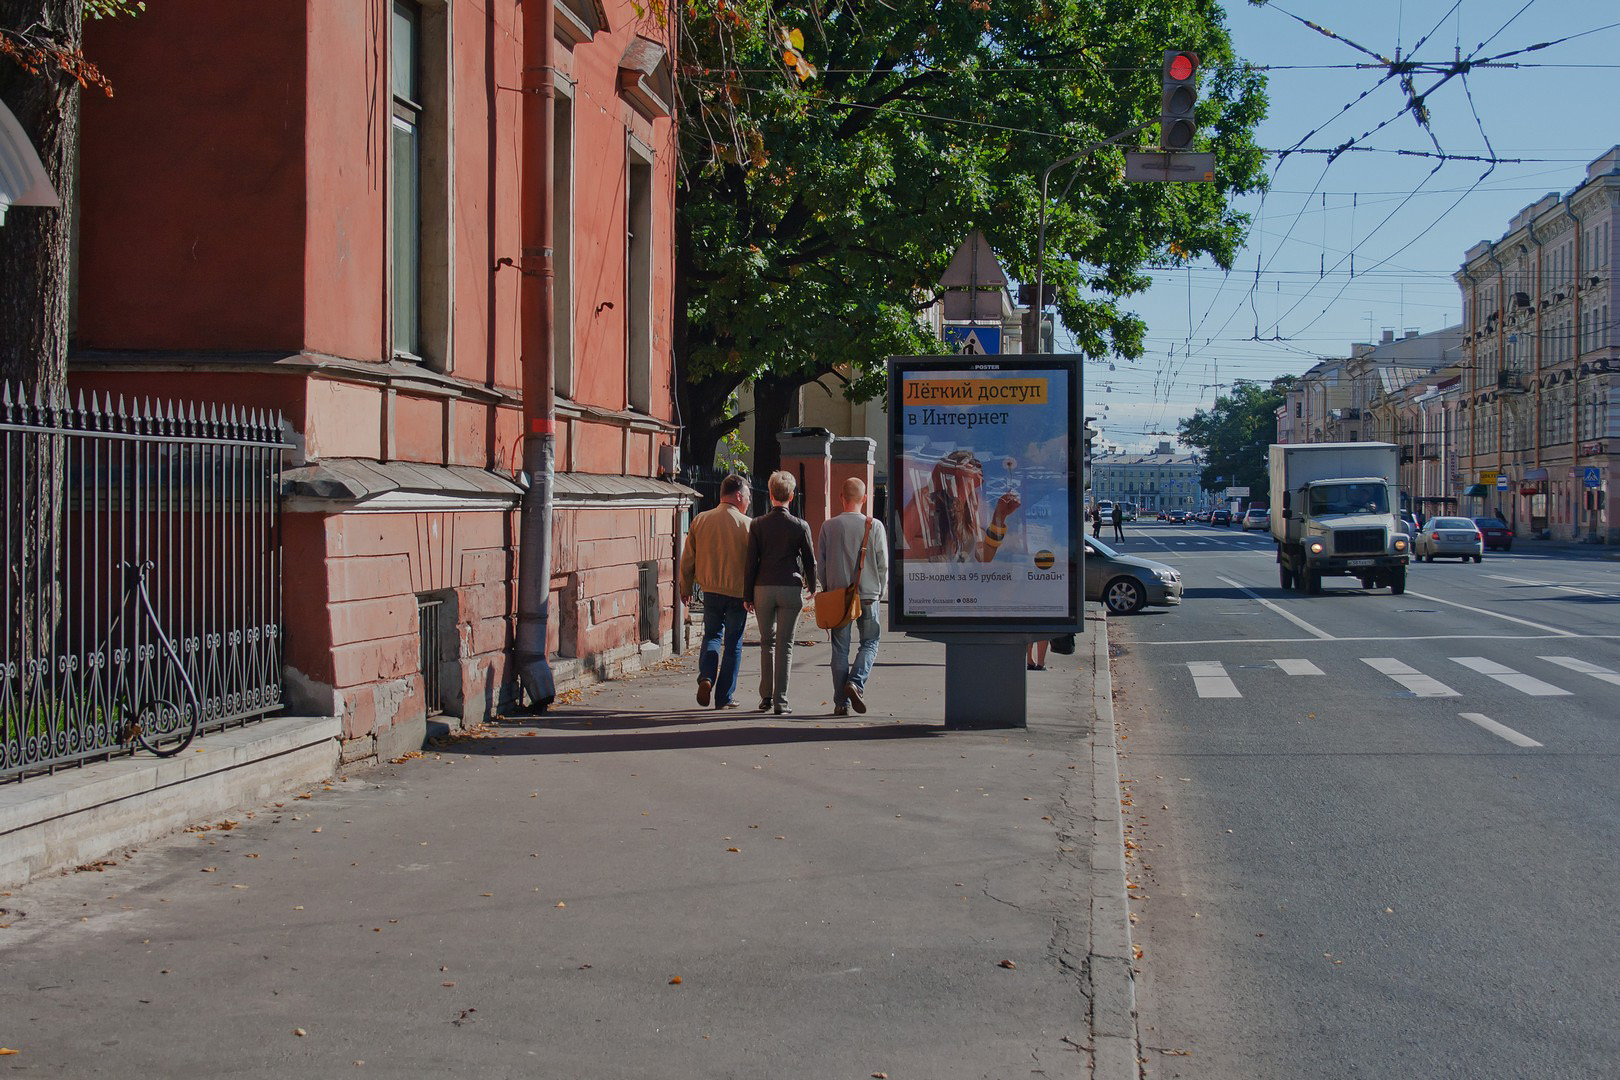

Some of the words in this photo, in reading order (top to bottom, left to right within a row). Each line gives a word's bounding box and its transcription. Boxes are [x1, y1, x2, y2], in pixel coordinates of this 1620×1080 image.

[907, 383, 972, 399] Лёгкий
[978, 385, 1040, 402] доступ
[908, 414, 917, 425] в
[922, 409, 1008, 428] Интернет
[909, 573, 955, 582] USB-модем
[968, 573, 978, 581] 95
[981, 572, 1012, 582] рублей
[1028, 572, 1064, 581] Билайн
